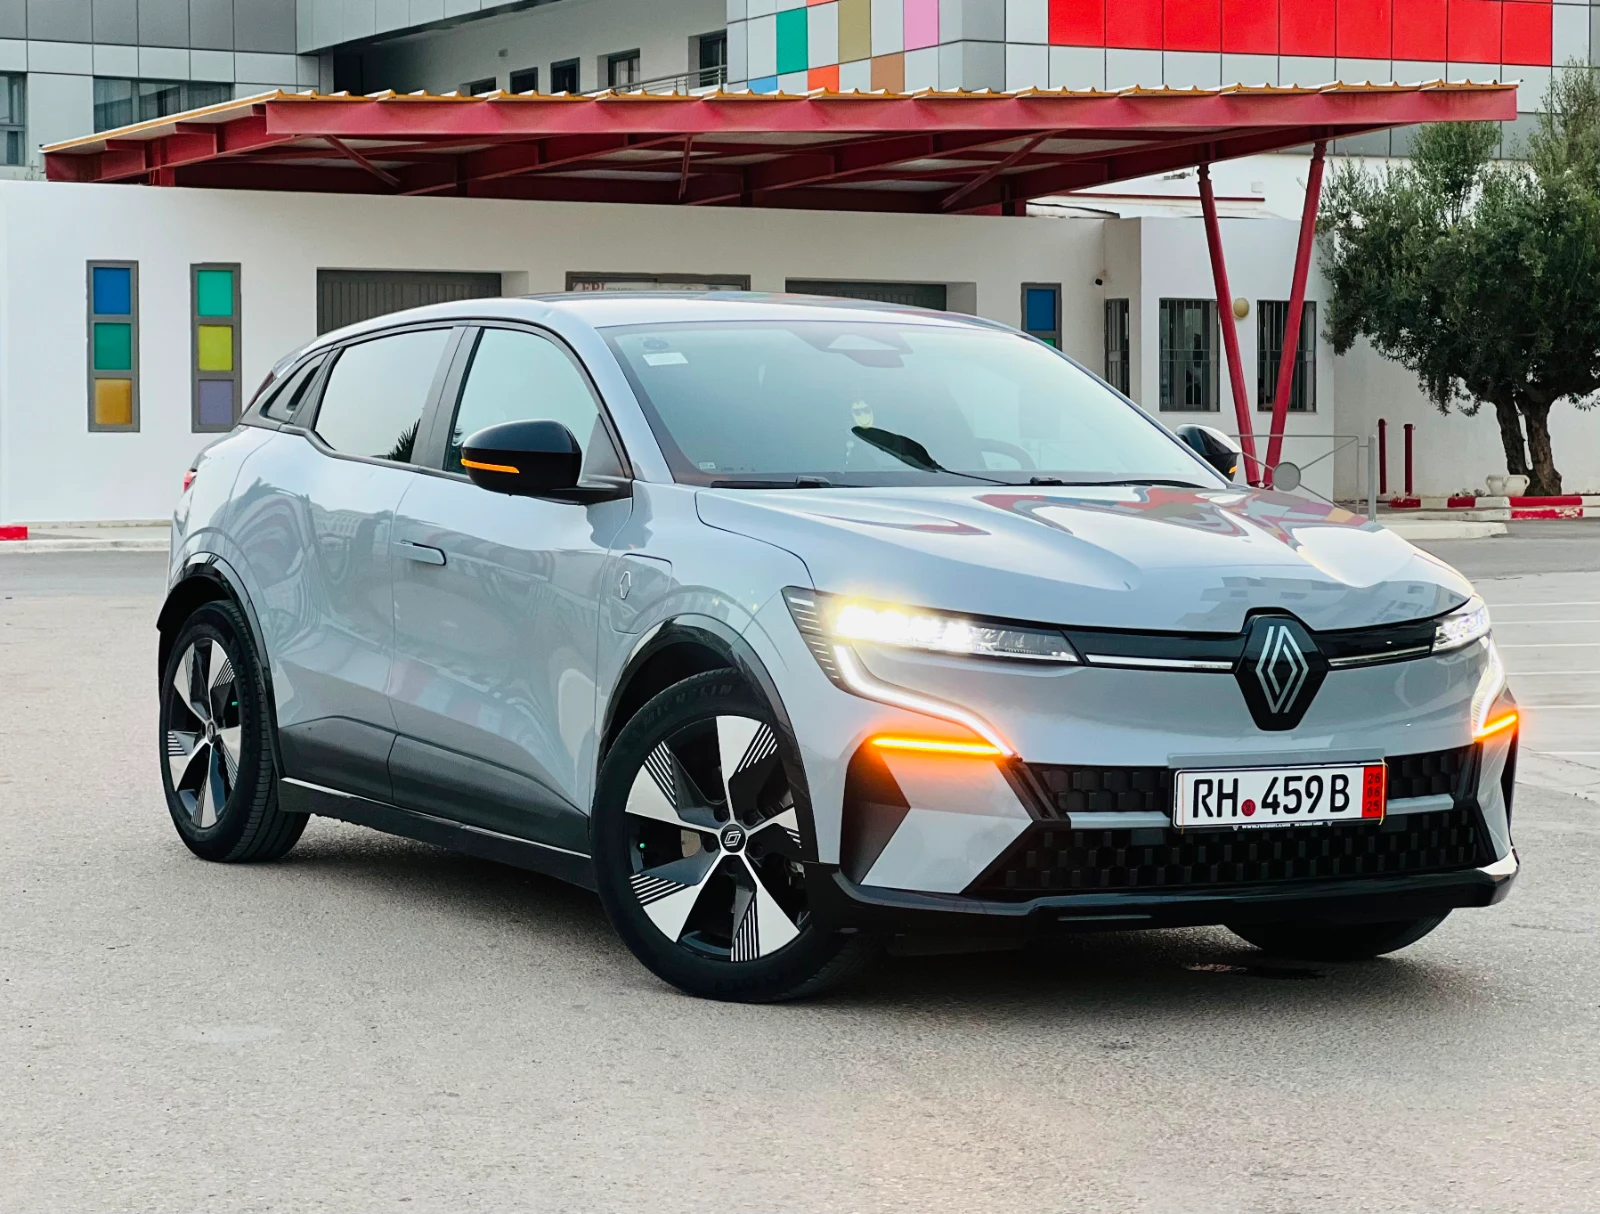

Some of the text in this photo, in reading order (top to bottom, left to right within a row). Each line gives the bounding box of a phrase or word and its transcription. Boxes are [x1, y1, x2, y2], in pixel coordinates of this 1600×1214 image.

[1367, 772, 1381, 784] 26
[1192, 778, 1239, 818] RH
[1367, 786, 1380, 798] 06
[1366, 800, 1379, 812] 25
